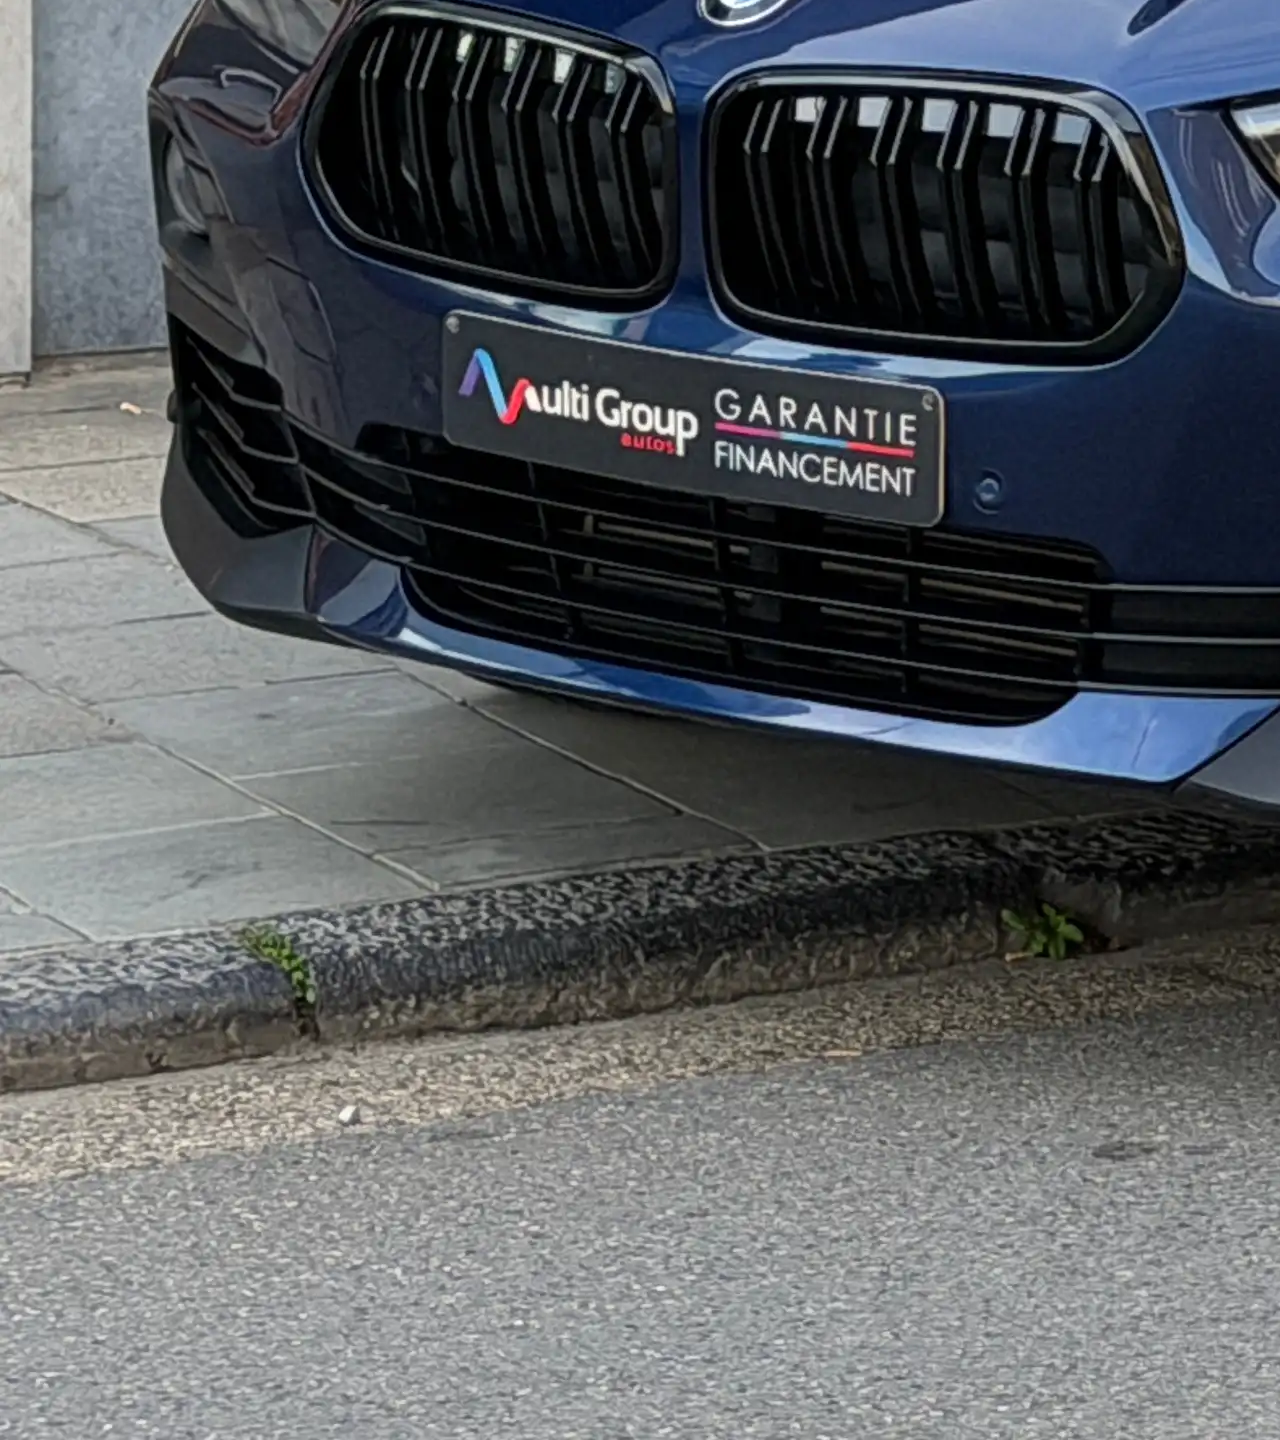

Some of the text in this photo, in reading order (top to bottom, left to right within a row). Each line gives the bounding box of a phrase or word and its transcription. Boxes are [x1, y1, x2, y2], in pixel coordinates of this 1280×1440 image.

[458, 347, 699, 457] Multi Group
[714, 388, 917, 447] GARANTIE
[714, 440, 916, 497] FINANCEMENT
